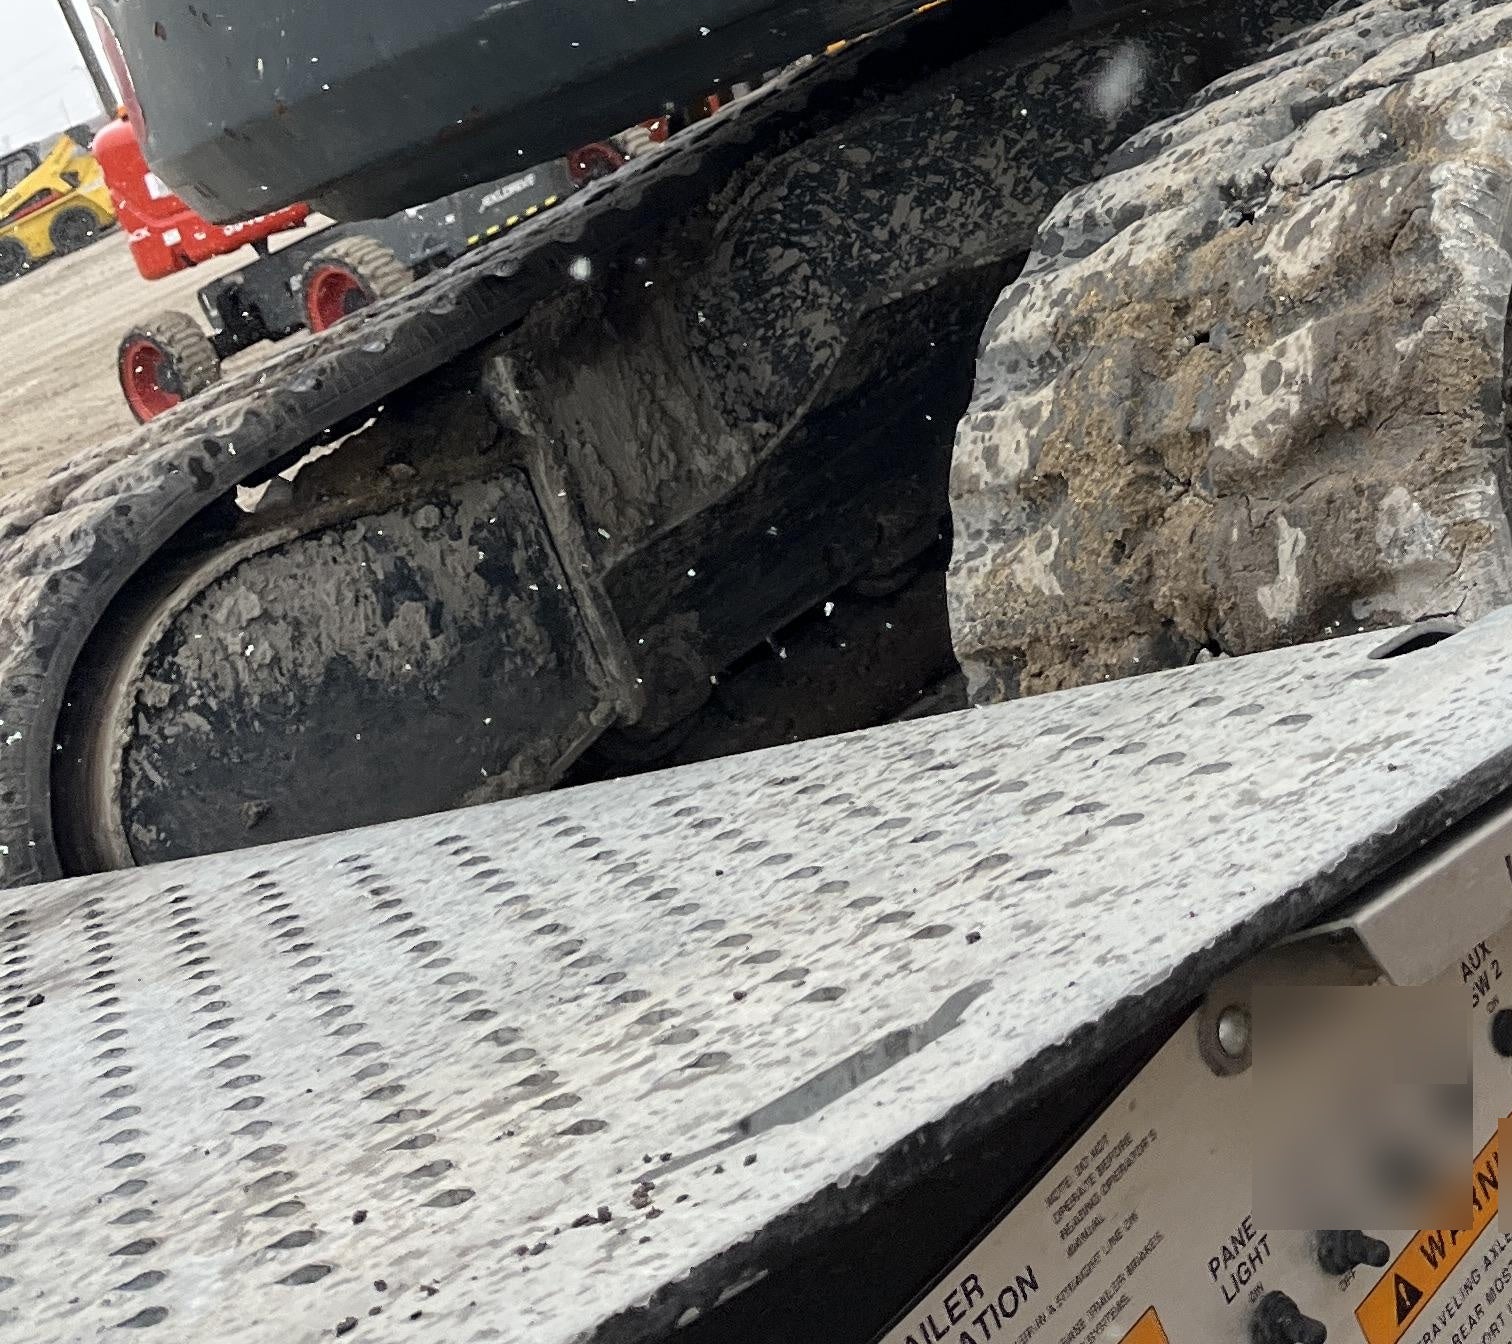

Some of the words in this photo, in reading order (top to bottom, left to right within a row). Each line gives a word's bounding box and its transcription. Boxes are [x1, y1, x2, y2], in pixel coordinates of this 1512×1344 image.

[1460, 940, 1492, 983] AUX
[1491, 959, 1503, 980] 2
[1207, 1213, 1257, 1282] PANE
[1220, 1233, 1272, 1305] LIGHT
[1416, 1267, 1482, 1344] RAVELING
